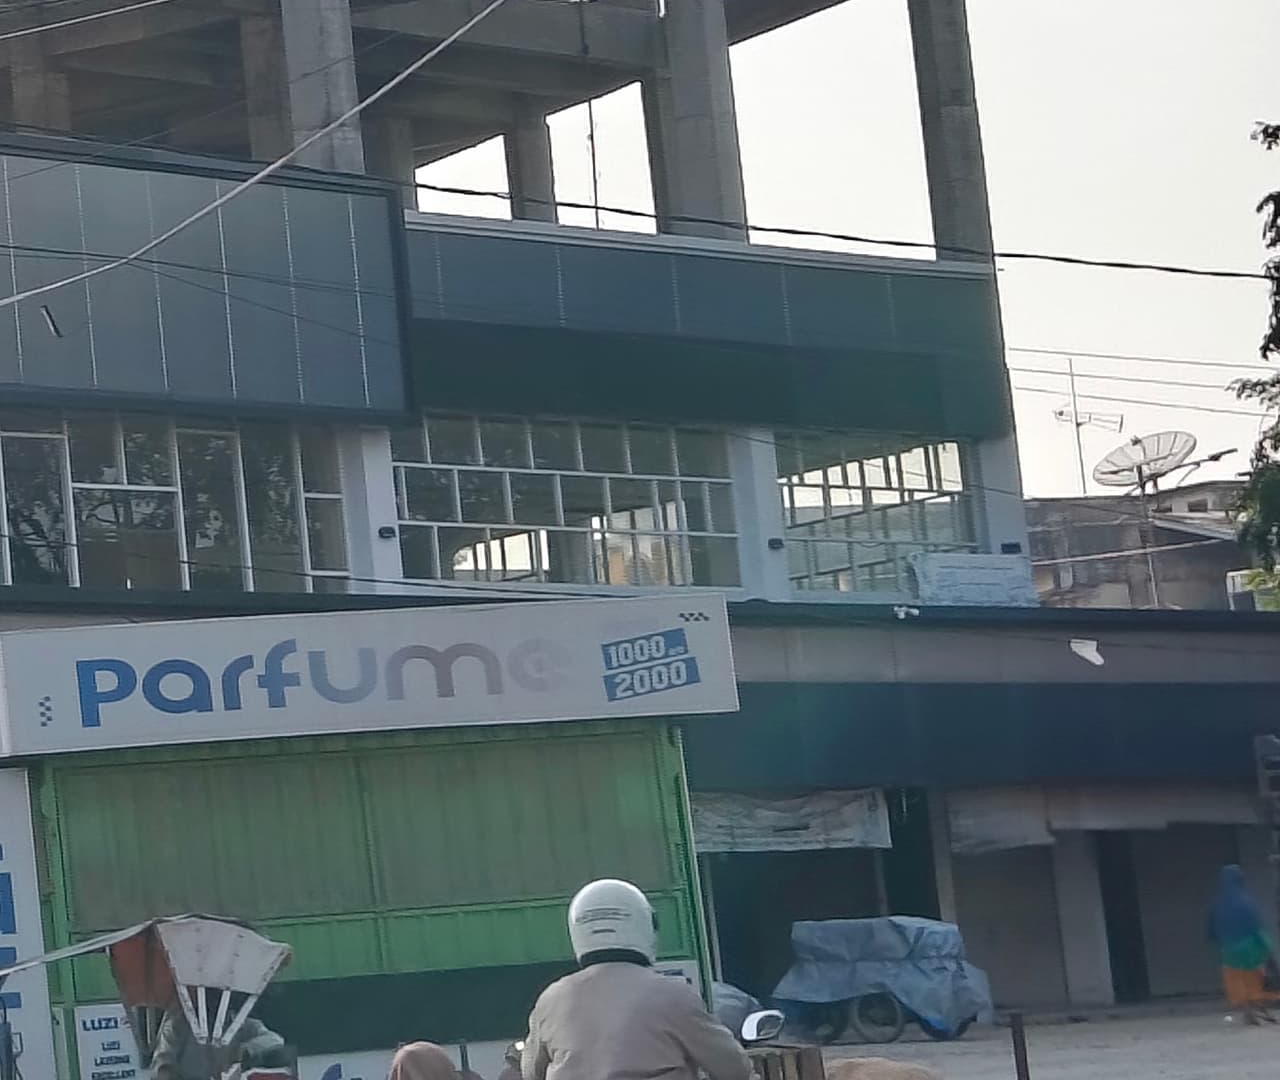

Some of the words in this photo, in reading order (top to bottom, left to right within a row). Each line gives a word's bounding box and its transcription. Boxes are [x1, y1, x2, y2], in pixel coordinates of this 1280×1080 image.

[608, 635, 665, 668] 1000
[613, 661, 688, 699] 2000
[82, 1017, 119, 1031] LUZI
